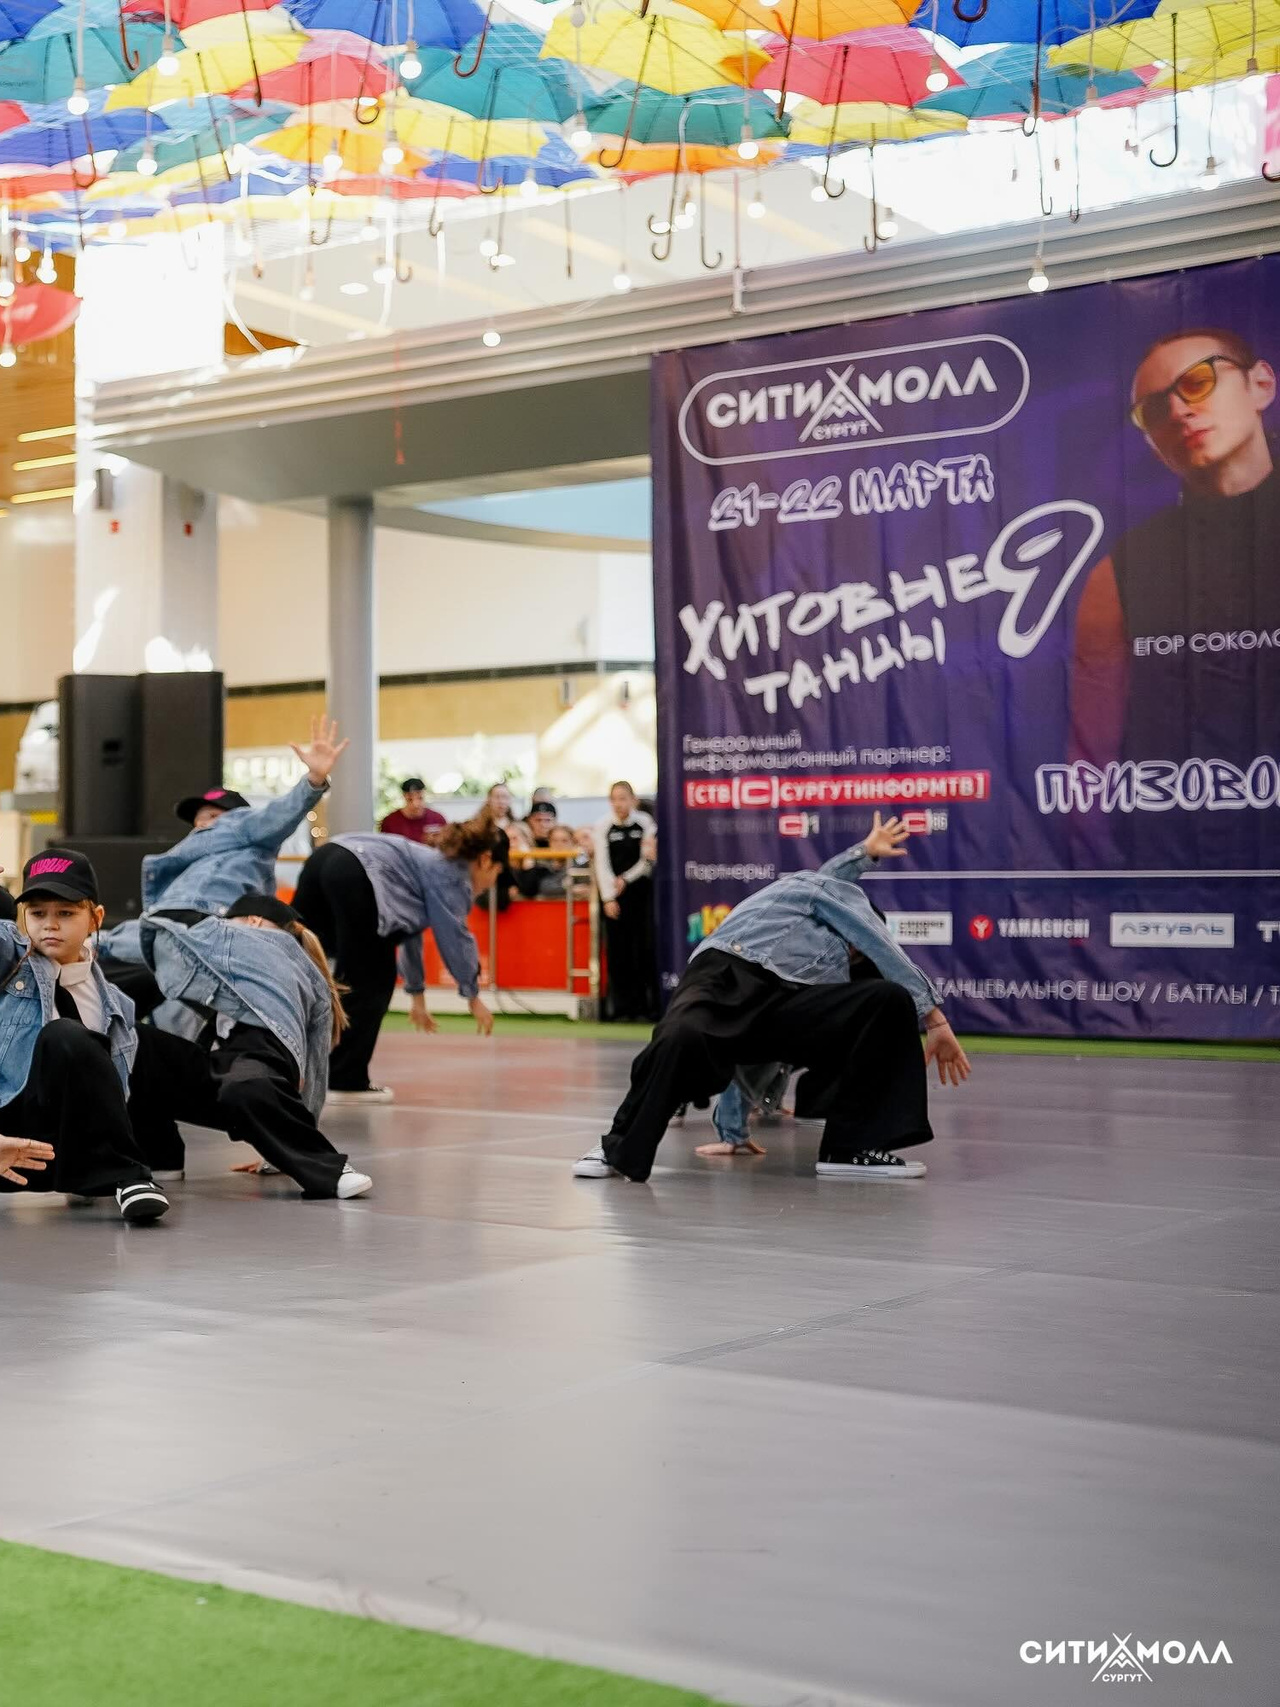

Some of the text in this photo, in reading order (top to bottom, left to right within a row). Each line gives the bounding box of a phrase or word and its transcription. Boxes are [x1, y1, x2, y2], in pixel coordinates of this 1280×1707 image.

[812, 419, 869, 440] СУРГУТ
[707, 453, 996, 532] 21-22 МАРТА
[677, 553, 996, 681] ХИТОВЫЕ
[1133, 634, 1186, 657] ЕГОР
[743, 616, 948, 714] ТАНЦЫ
[683, 729, 802, 753] Генеральный
[683, 744, 951, 775] информационный партнер:
[1035, 755, 1280, 815] ПРИЗОВО
[685, 861, 775, 882] Партнеры:
[997, 917, 1090, 938] YAMAGUCHI
[934, 977, 1087, 1001] ТАНЦЕВАЛЬНОЕ
[1092, 981, 1146, 1002] ШОУ
[1166, 982, 1247, 1005] БАТТЛЫ
